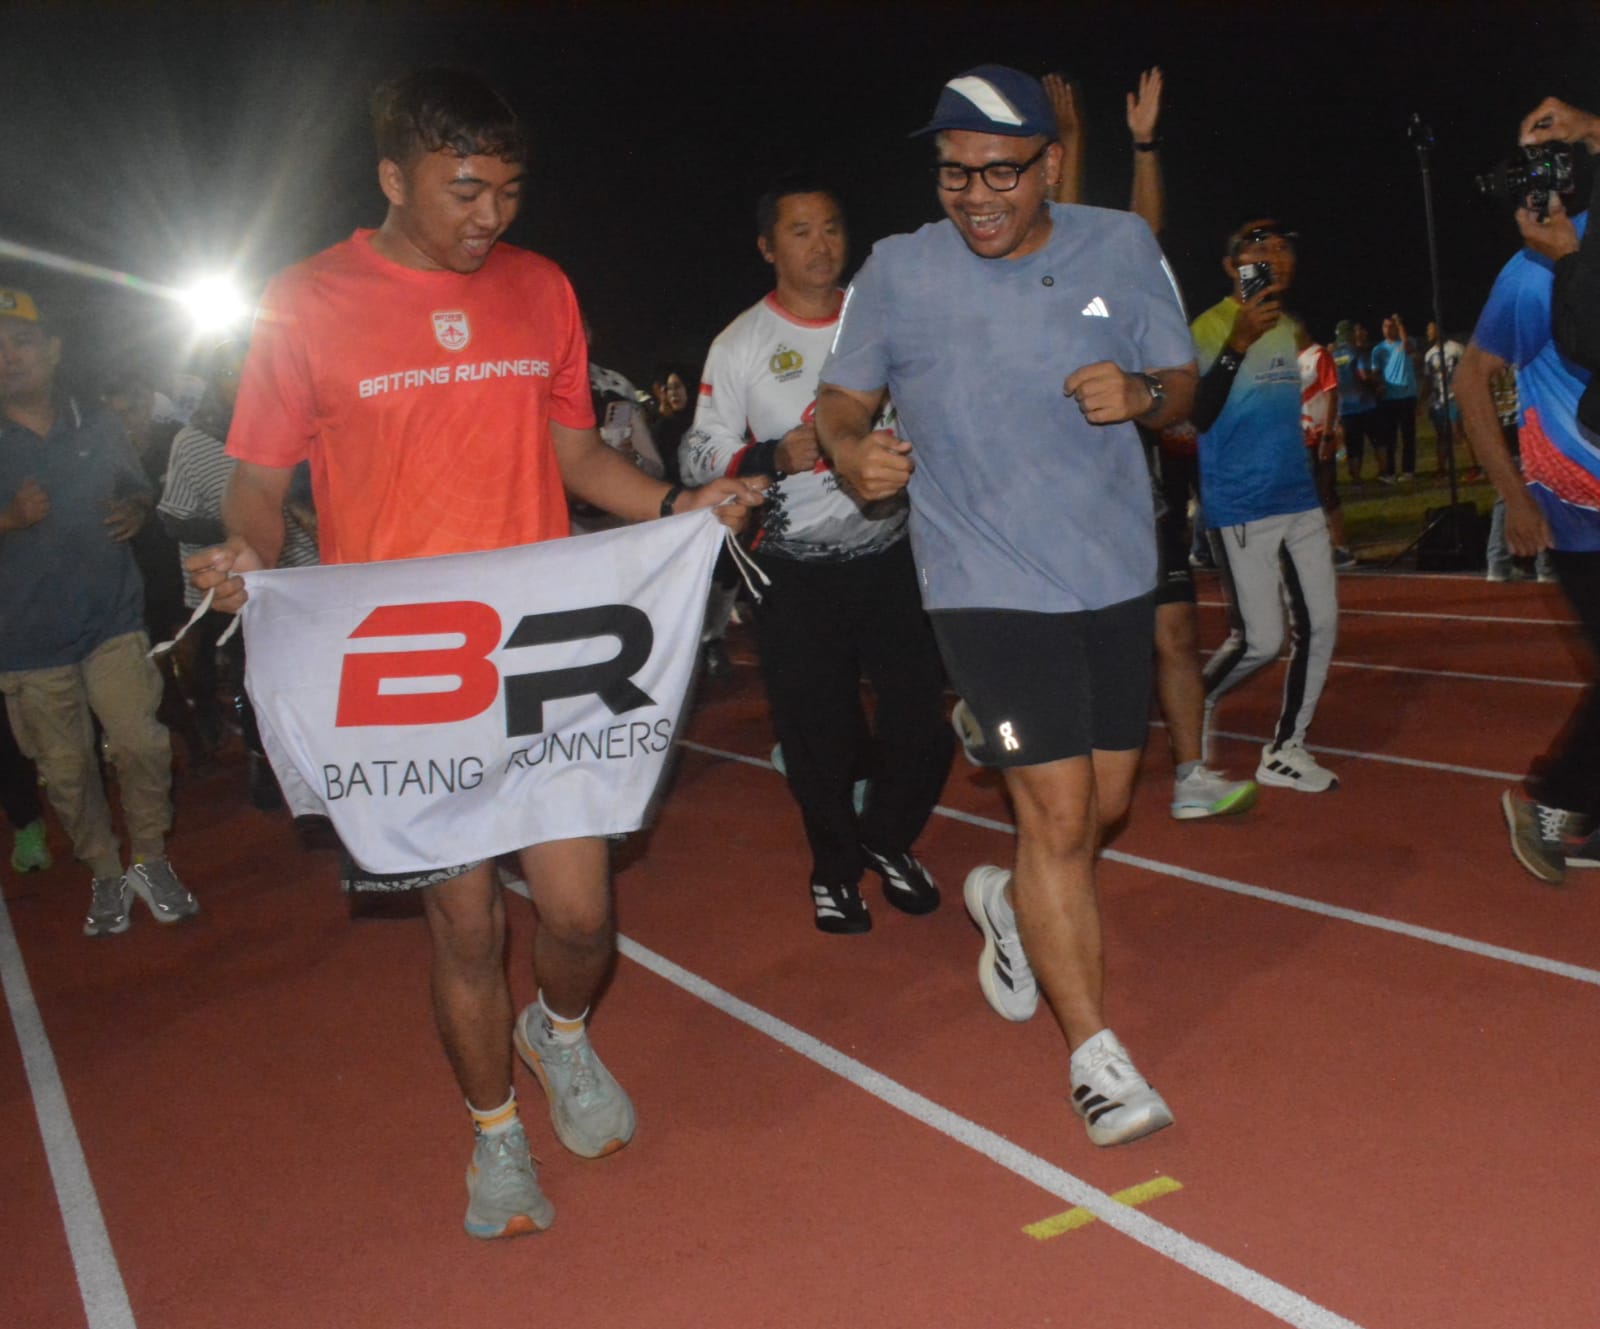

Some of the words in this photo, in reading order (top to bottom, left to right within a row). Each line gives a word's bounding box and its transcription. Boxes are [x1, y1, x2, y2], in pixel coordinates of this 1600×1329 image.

[358, 365, 451, 399] BATANG
[454, 359, 550, 382] RUNNERS
[335, 600, 657, 738] BR
[323, 756, 484, 800] BATANG
